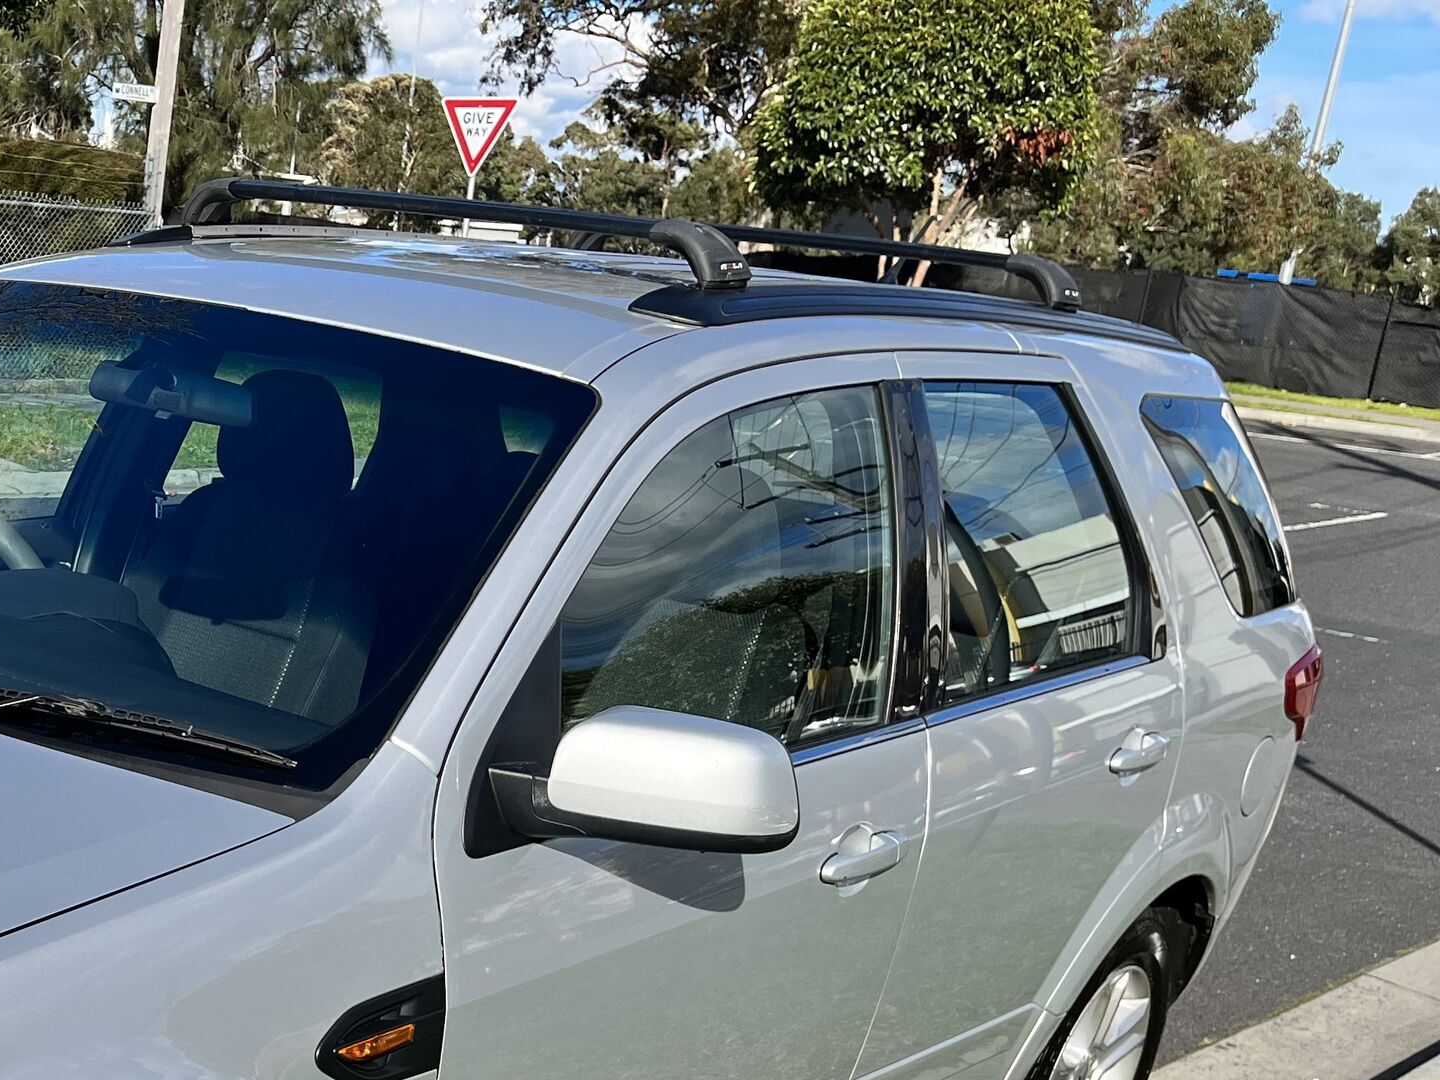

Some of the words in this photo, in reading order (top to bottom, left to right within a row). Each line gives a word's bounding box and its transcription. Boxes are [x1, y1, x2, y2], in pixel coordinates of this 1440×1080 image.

[121, 84, 150, 97] CONNELL
[463, 112, 495, 124] GIVE
[466, 127, 488, 137] WAY
